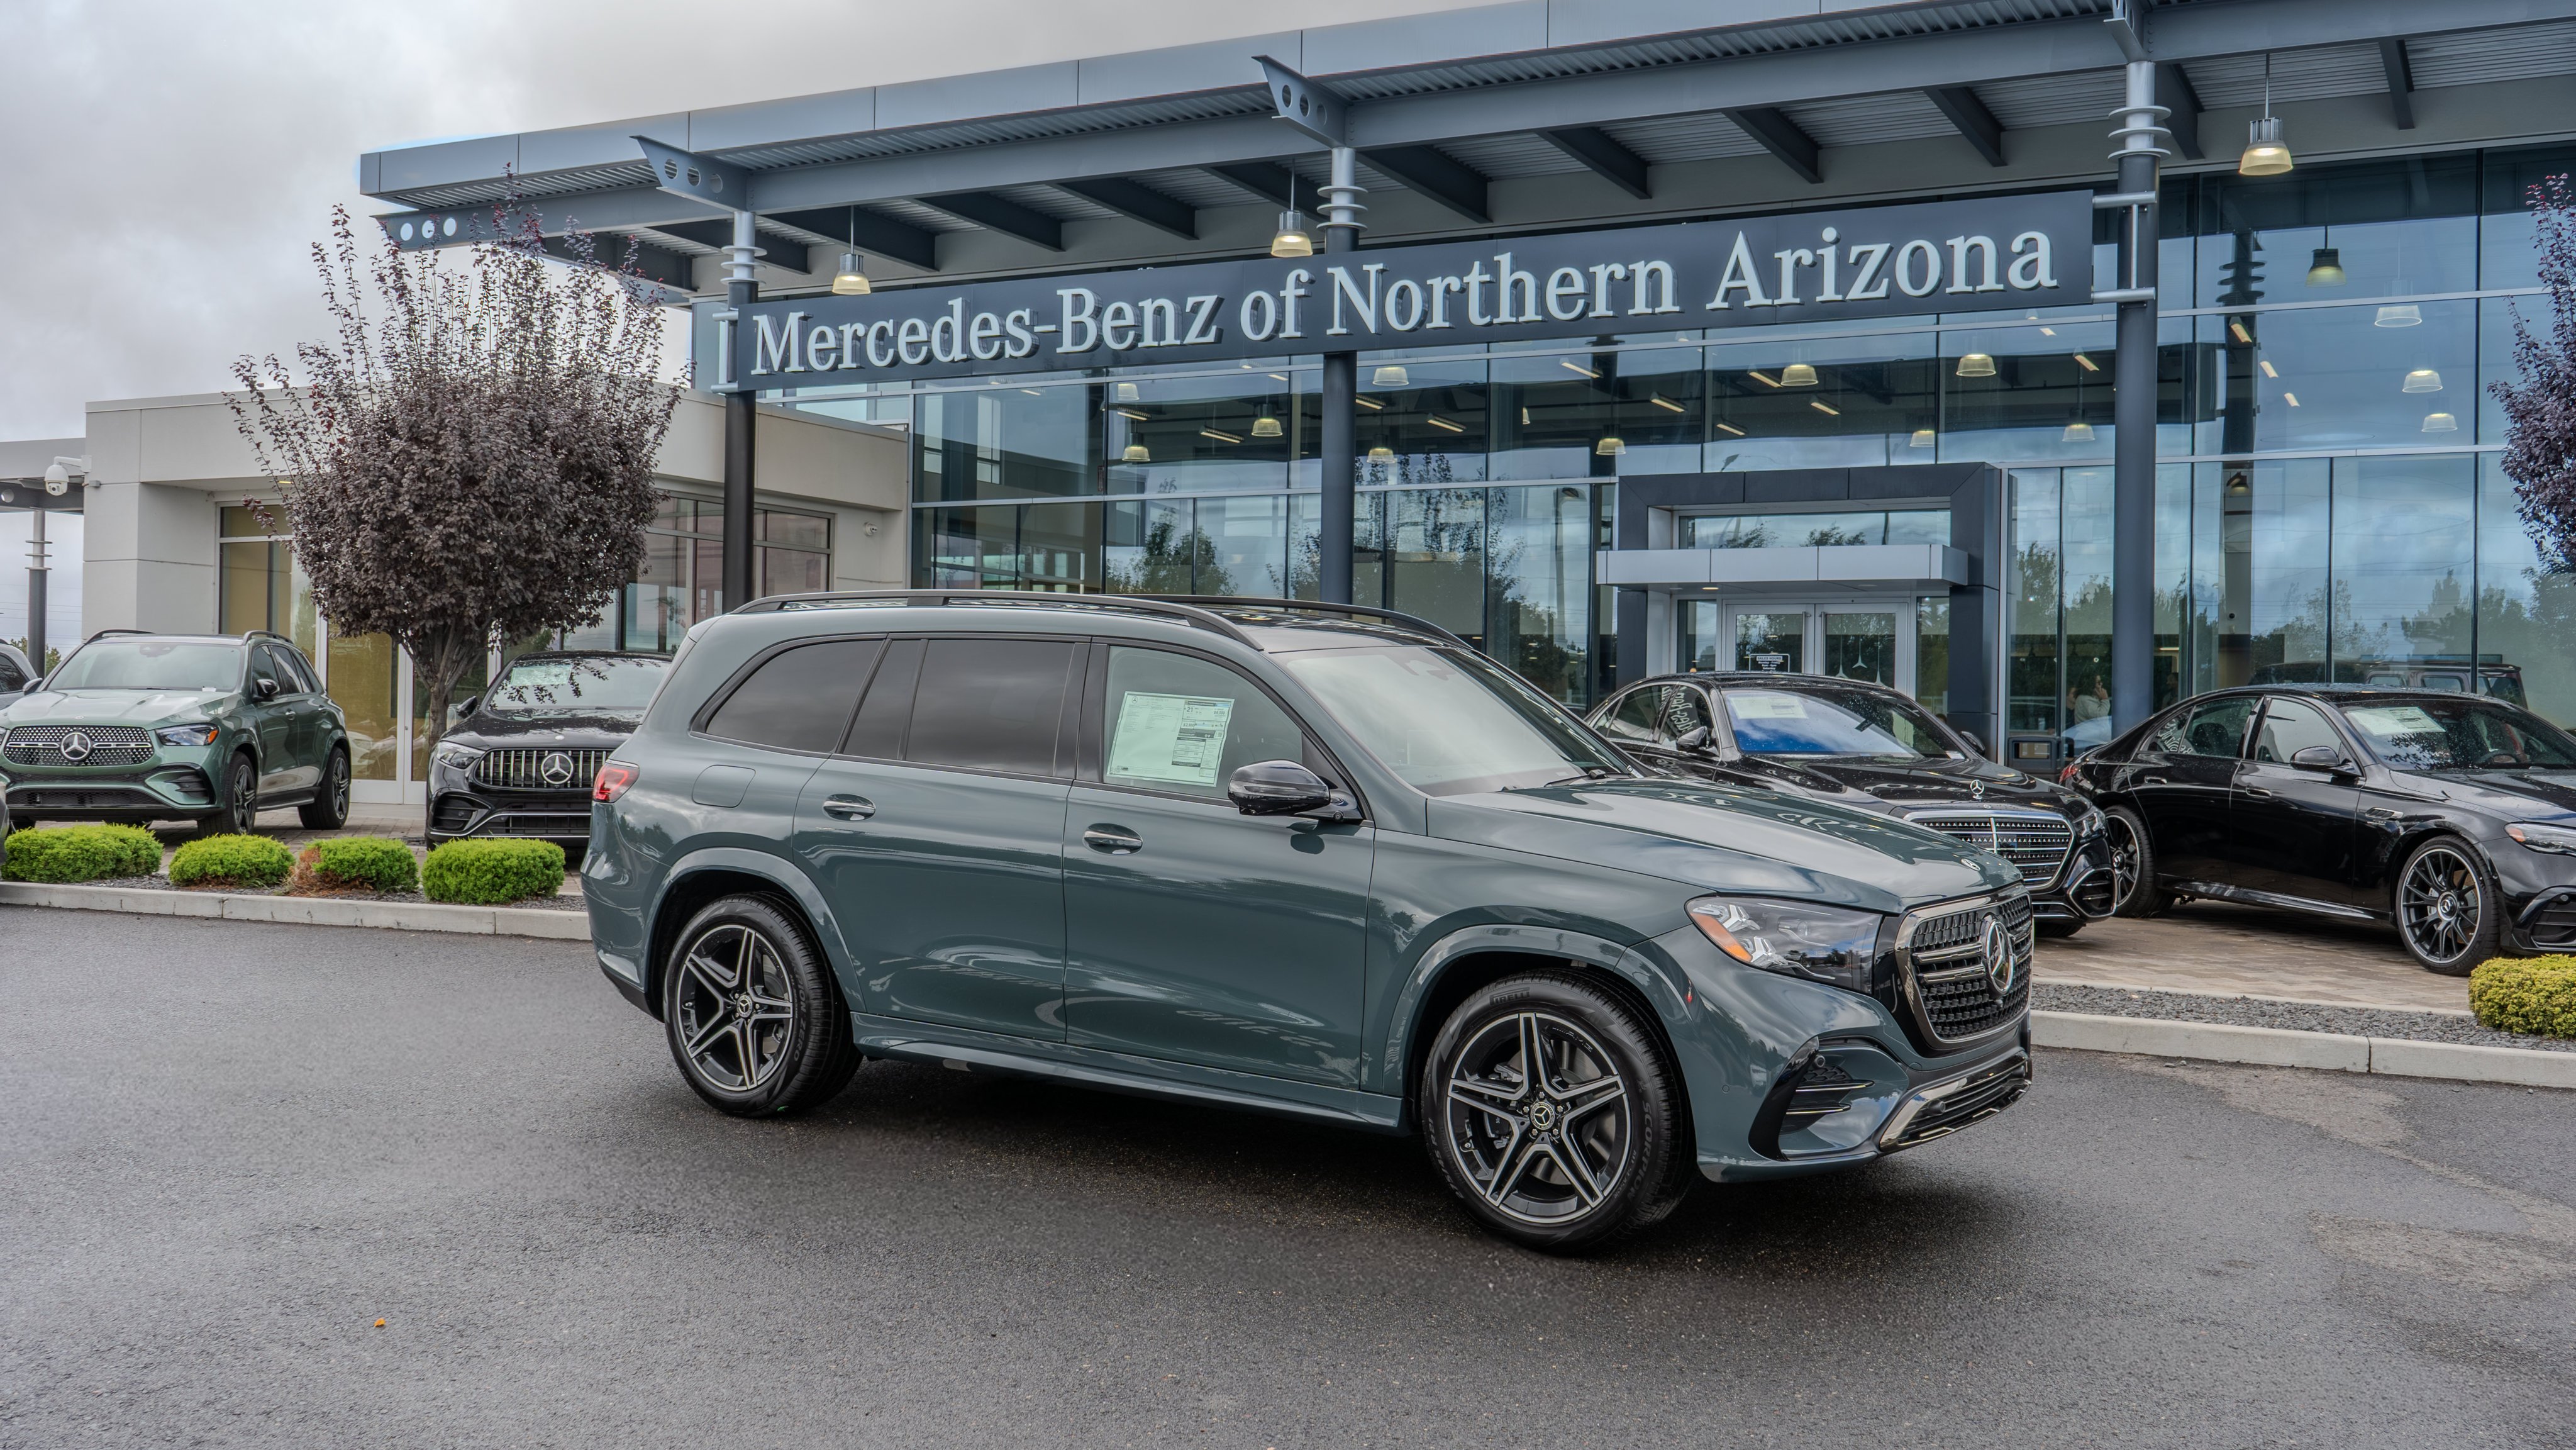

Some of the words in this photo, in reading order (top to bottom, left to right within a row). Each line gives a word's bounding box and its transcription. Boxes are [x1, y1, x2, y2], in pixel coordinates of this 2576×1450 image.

[751, 287, 1223, 375] Mercedes-Benz
[1240, 269, 1315, 340] of
[1326, 253, 1682, 338] Northern
[1706, 226, 2058, 313] Arizona
[779, 936, 806, 1012] SCORPION
[794, 1020, 806, 1062] ZERO
[1489, 986, 1530, 1006] PIRELLI
[1627, 1100, 1653, 1202] SCORPION
